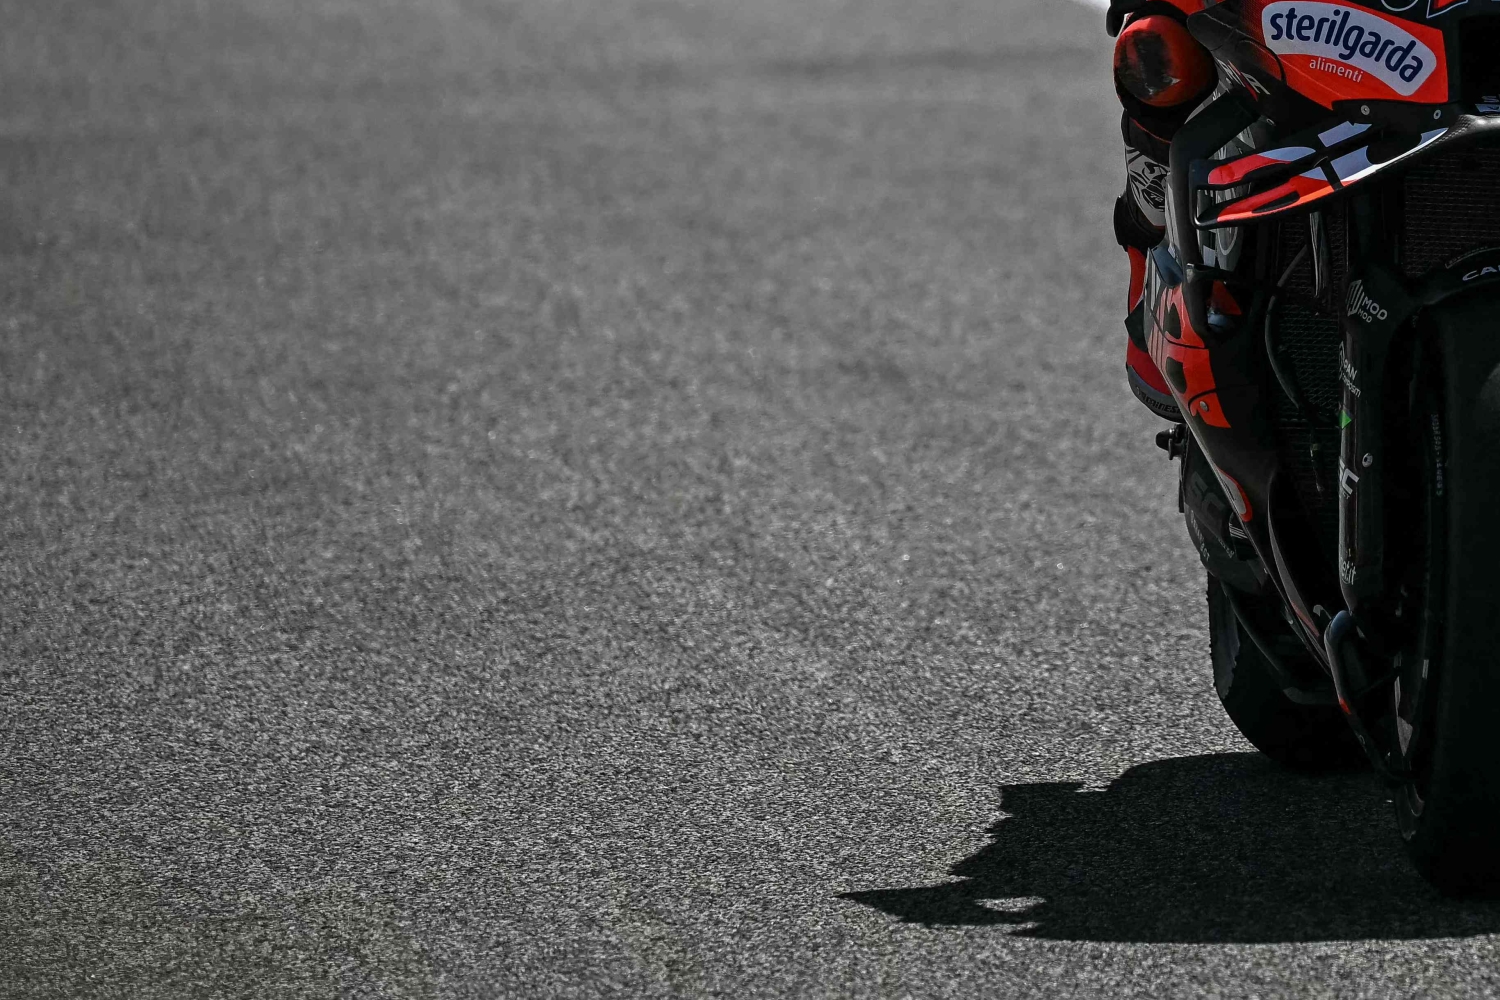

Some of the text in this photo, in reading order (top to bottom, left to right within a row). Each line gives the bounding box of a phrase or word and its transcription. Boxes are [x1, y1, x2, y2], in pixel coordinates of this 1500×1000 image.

[1270, 7, 1424, 83] sterilgarda
[1309, 57, 1364, 83] alimenti
[1361, 295, 1388, 321] MOD
